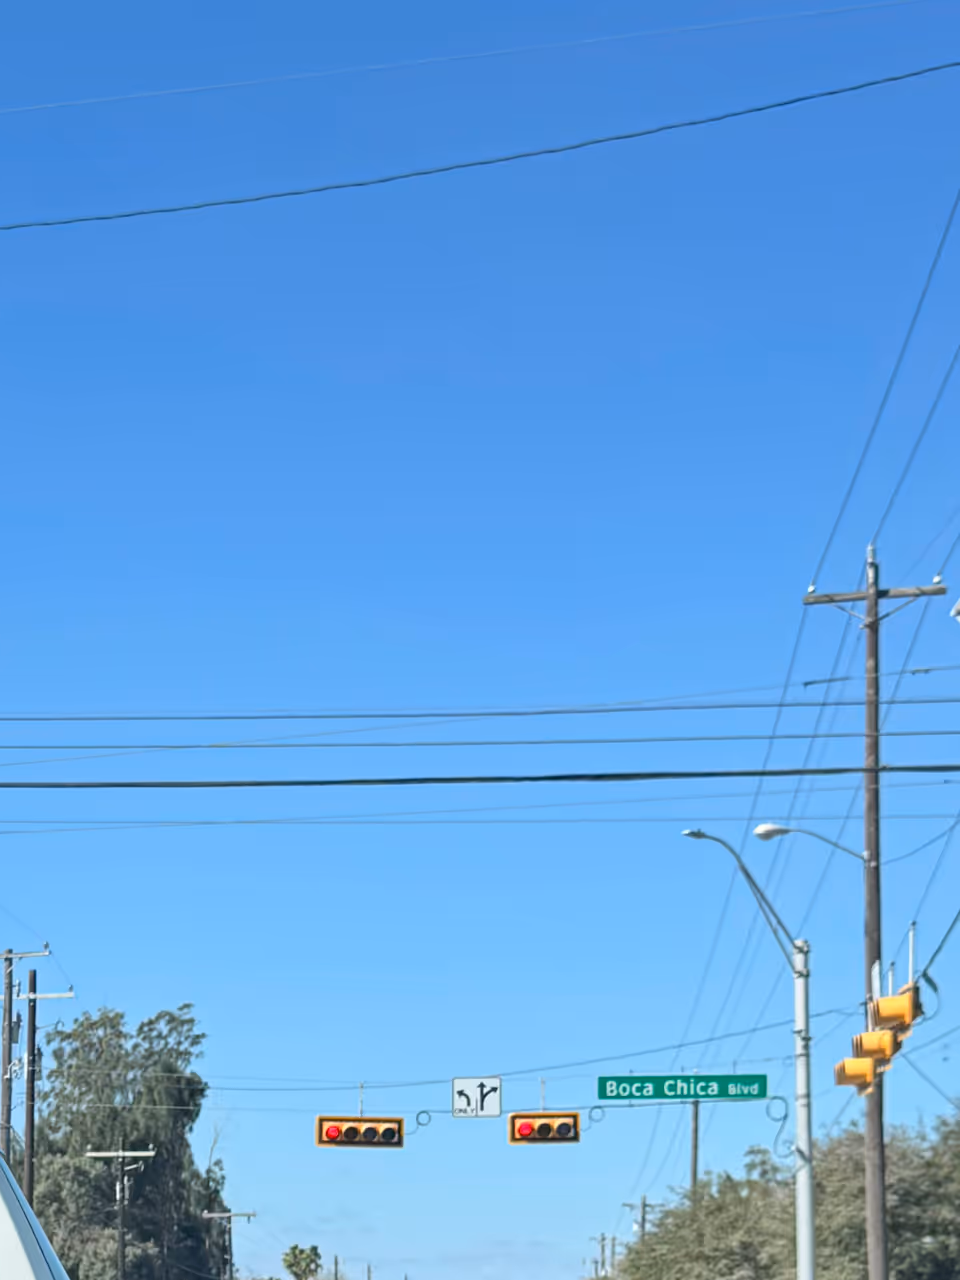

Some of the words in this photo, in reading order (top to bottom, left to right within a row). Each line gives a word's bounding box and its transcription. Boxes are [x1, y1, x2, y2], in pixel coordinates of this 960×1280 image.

[606, 1080, 653, 1097] Boca
[664, 1079, 719, 1096] Chica
[728, 1082, 759, 1095] Blvd
